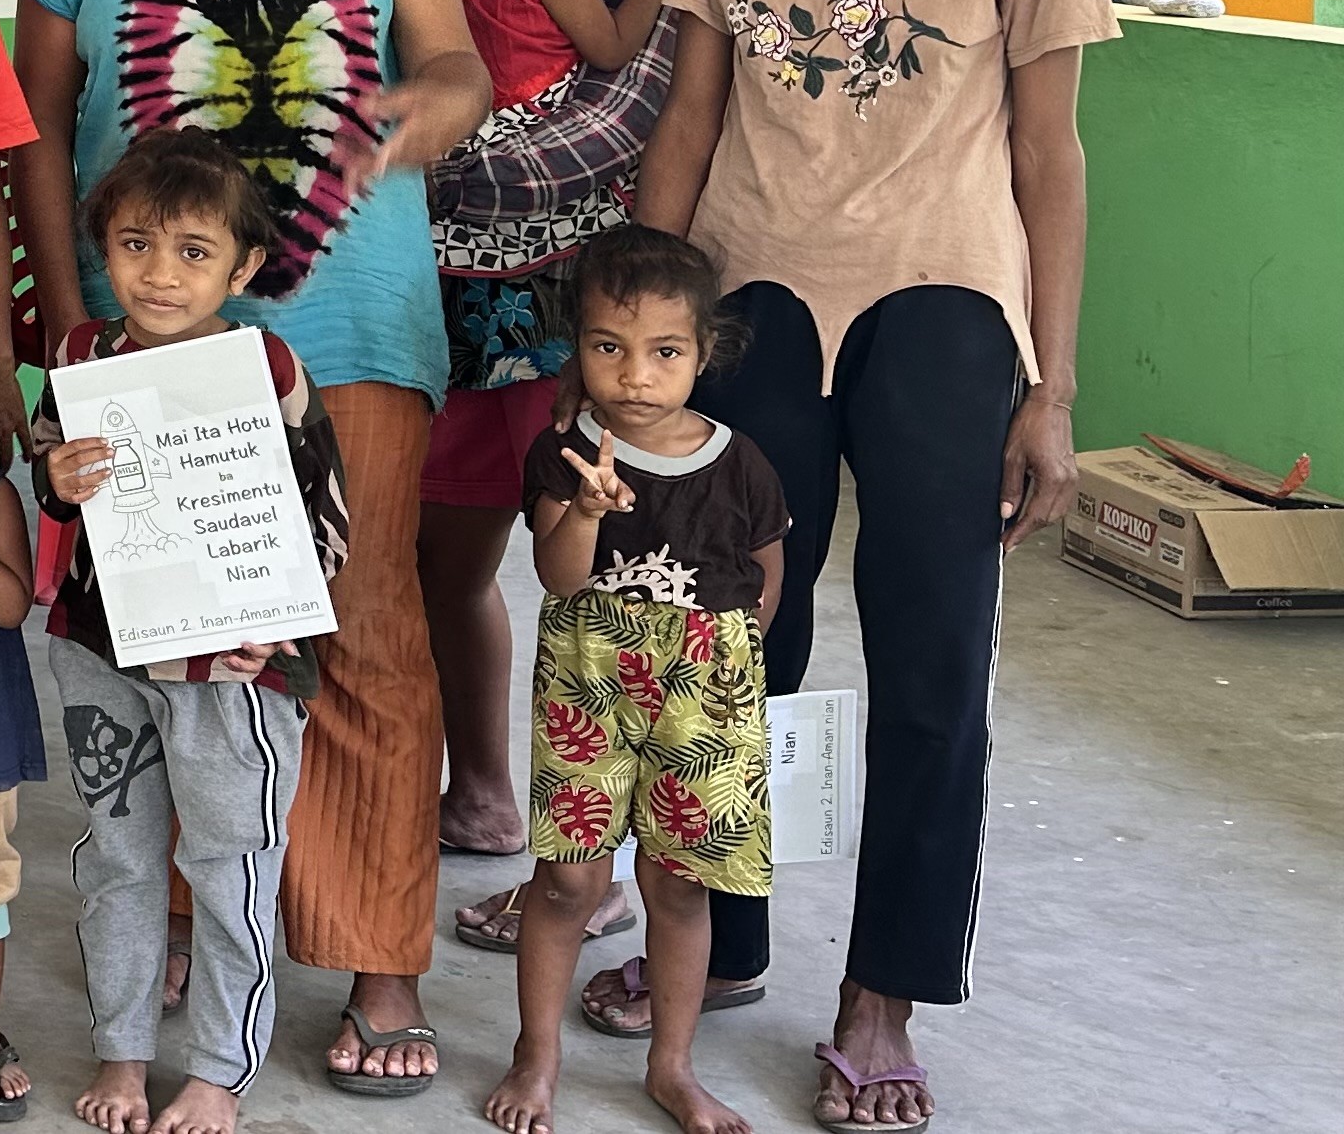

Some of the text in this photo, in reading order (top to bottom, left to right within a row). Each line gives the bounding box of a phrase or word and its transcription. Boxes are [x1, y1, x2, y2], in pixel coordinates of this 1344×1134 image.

[156, 416, 271, 449] Mai Ita Hotu
[179, 442, 261, 470] Hamutuk
[218, 472, 234, 482] ba
[177, 482, 283, 512] Kresimentu
[193, 505, 279, 535] Saudavel
[1103, 503, 1152, 543] KOPIKO
[207, 533, 281, 559] Labarik
[226, 564, 271, 582] Nian
[1256, 597, 1293, 608] Coffee
[118, 624, 175, 642] Edisaun
[200, 606, 281, 629] Inan-Aman
[286, 600, 320, 615] nian
[822, 699, 835, 725] nian
[781, 731, 797, 764] Nian
[820, 728, 834, 790] Inan-Aman
[820, 809, 834, 855] Edisaun
